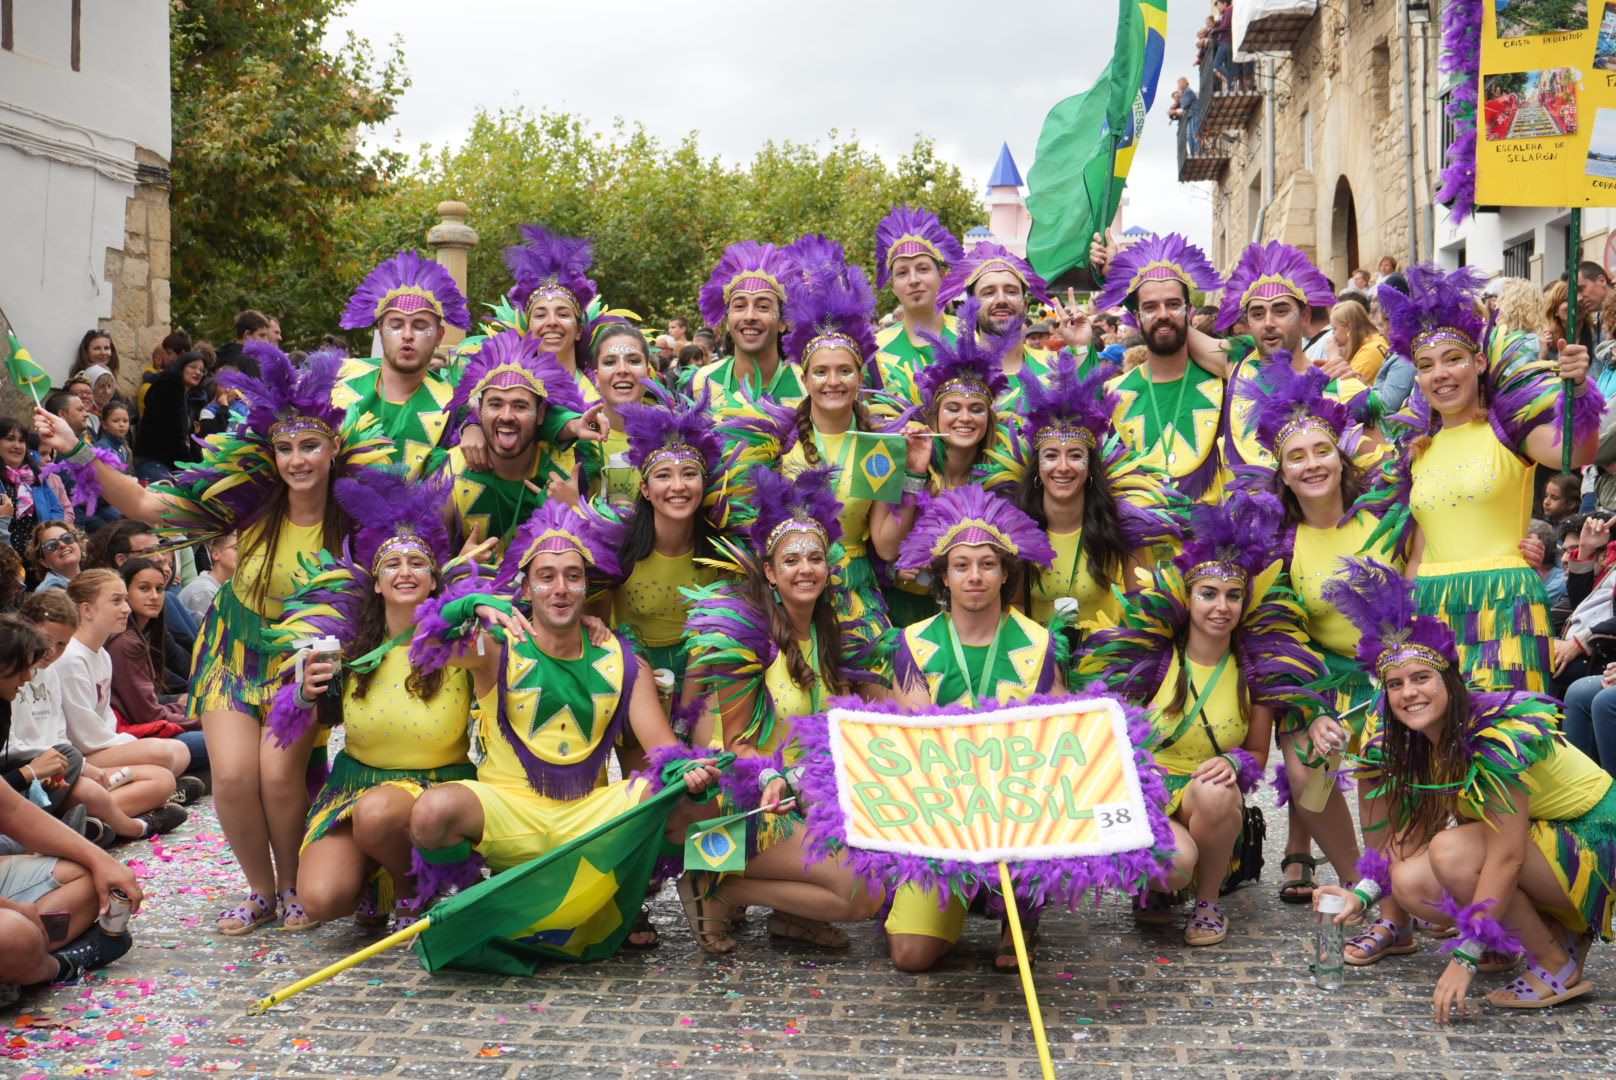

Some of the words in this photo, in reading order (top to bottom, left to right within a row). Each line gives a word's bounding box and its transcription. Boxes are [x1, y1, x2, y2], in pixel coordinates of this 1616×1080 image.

[1495, 143, 1543, 153] ESCALERA
[1555, 141, 1566, 149] DE
[867, 731, 1087, 777] SAMBA
[943, 773, 978, 789] DO
[1099, 808, 1132, 828] 38
